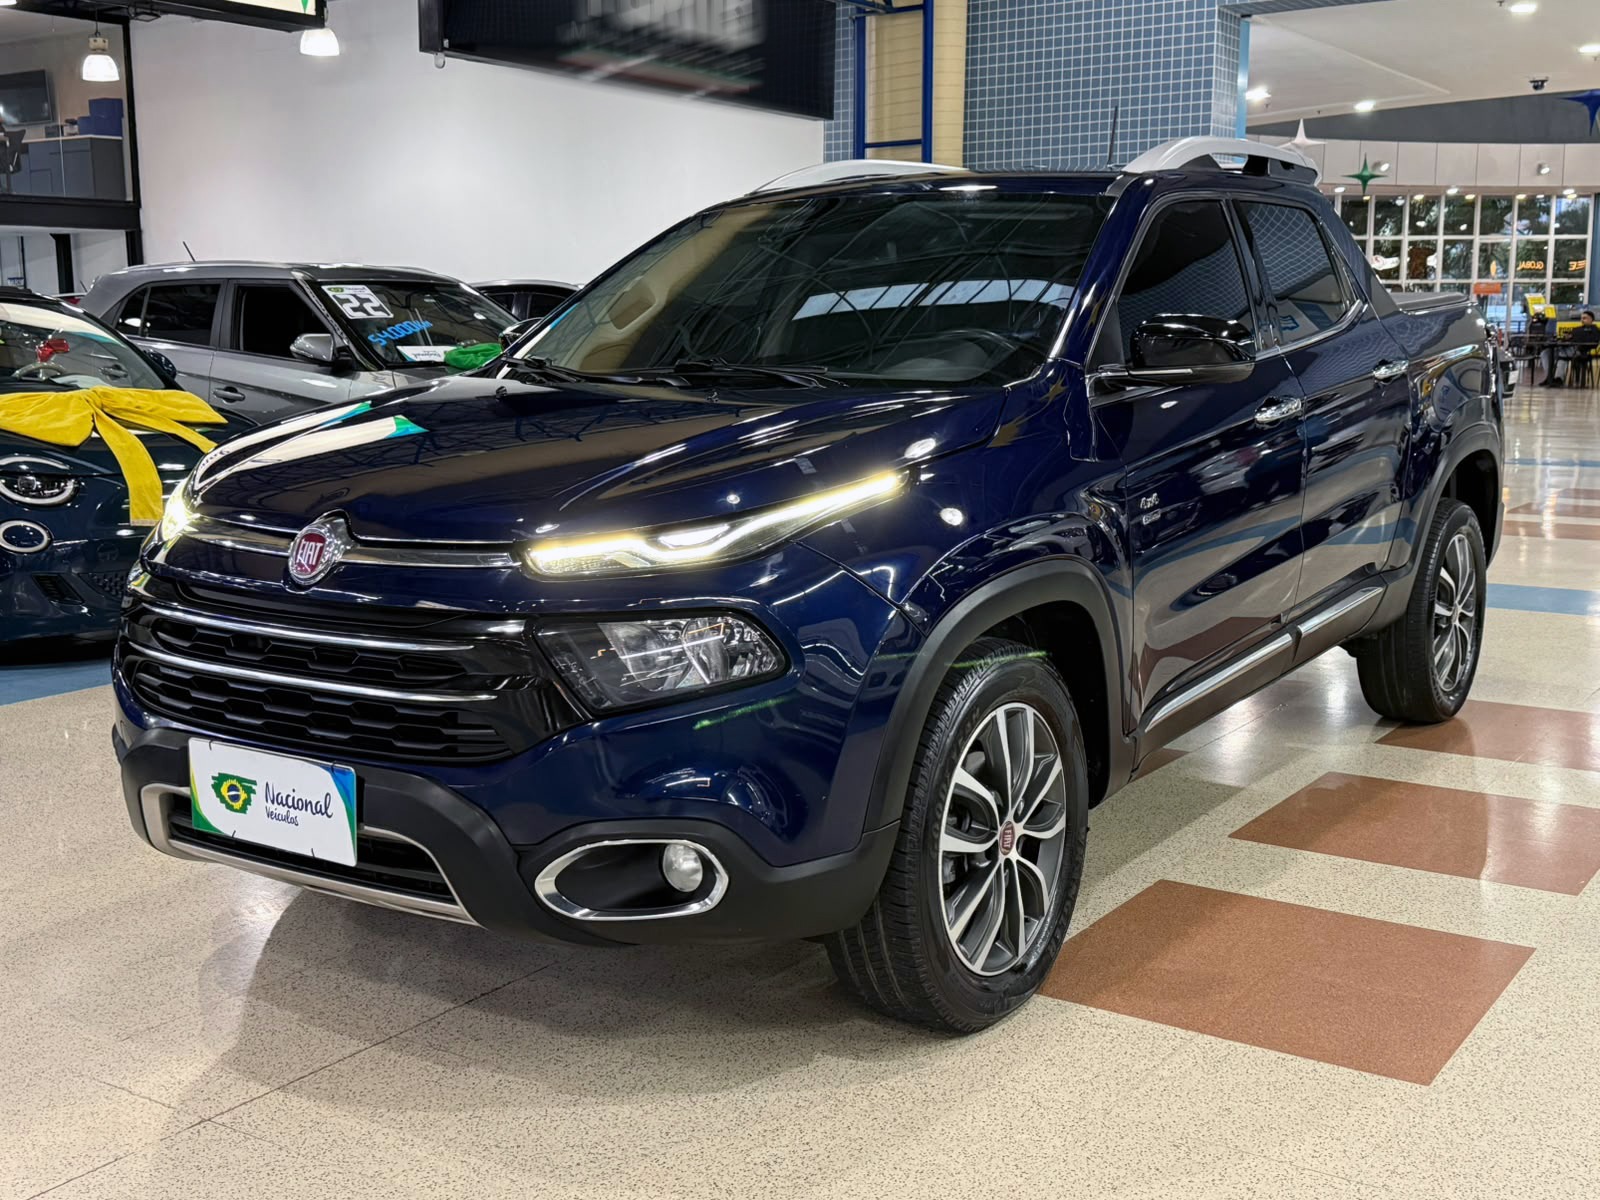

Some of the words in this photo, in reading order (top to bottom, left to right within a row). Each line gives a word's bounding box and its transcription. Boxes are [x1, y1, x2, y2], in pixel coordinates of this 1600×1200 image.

[334, 294, 390, 317] 22
[296, 538, 324, 566] FIAT
[265, 781, 334, 818] Nacional
